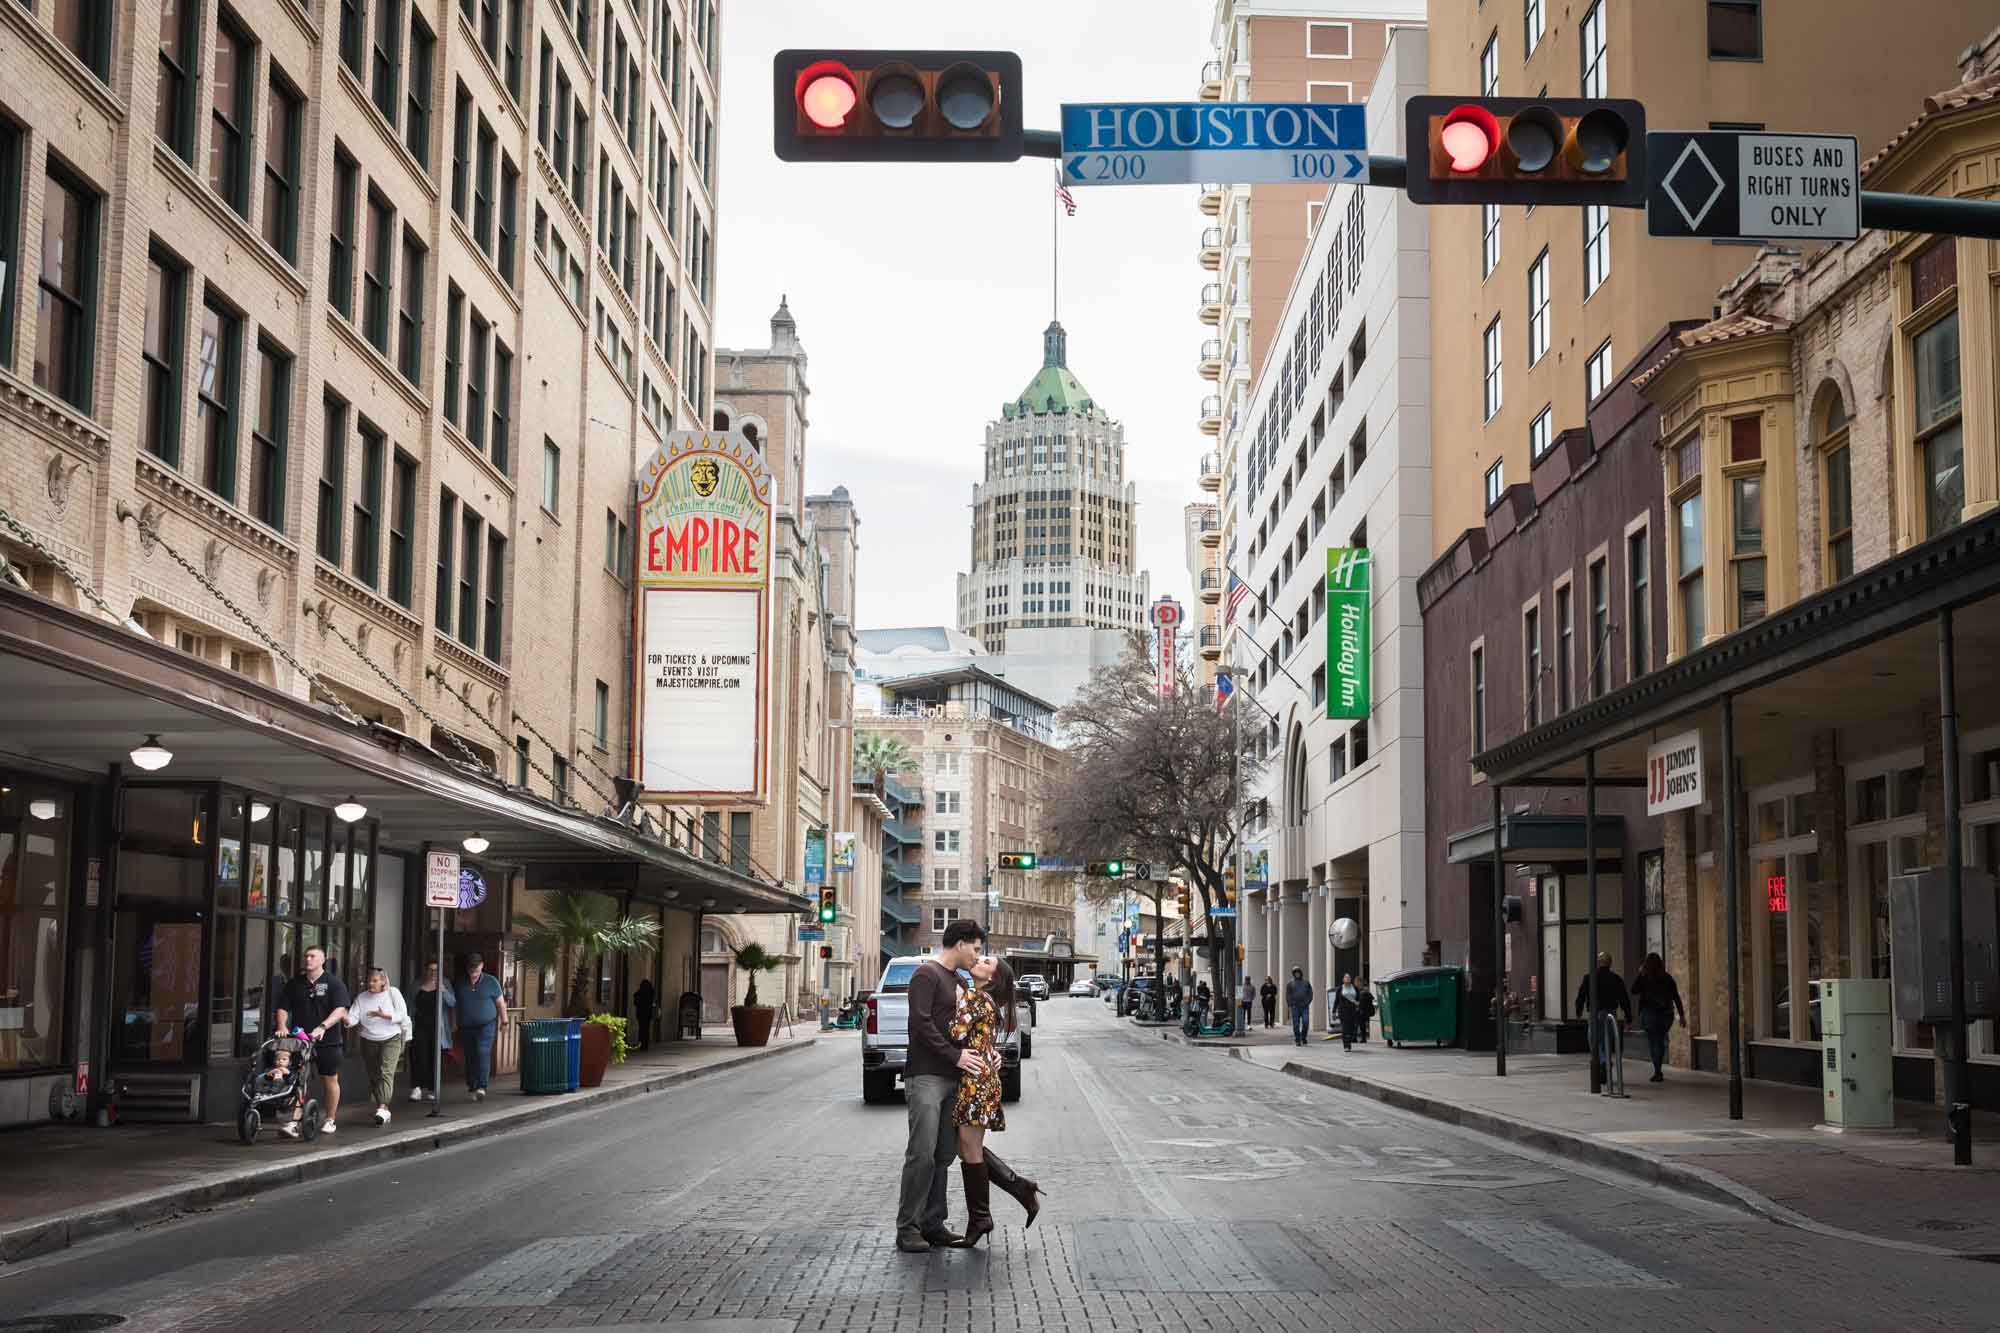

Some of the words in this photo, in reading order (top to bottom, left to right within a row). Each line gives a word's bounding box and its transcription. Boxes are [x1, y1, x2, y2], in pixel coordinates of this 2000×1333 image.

[1084, 108, 1343, 148] HOUSTON
[1095, 154, 1146, 180] 200
[1290, 153, 1335, 178] 100
[1753, 146, 1803, 166] BUSES
[1813, 148, 1843, 168] AND
[1748, 176, 1792, 196] RIGHT
[1801, 177, 1849, 197] TURNS
[1771, 206, 1827, 226] ONLY
[648, 517, 760, 573] EMPIRE
[1337, 603, 1361, 678] Holiday
[648, 654, 662, 664] FOR
[666, 655, 697, 665] TICKETS
[701, 656, 707, 665] &
[711, 655, 751, 665] UPCOMING
[656, 678, 741, 688] MAJESTICEMPIRE.COM
[663, 667, 693, 676] EVENTS
[697, 667, 719, 677] VISIT
[1341, 678, 1361, 708] Inn
[1666, 746, 1697, 777] JIMMY
[1666, 772, 1697, 801] JOHN'S
[436, 856, 450, 867] NO
[1237, 1144, 1455, 1168] BUS
